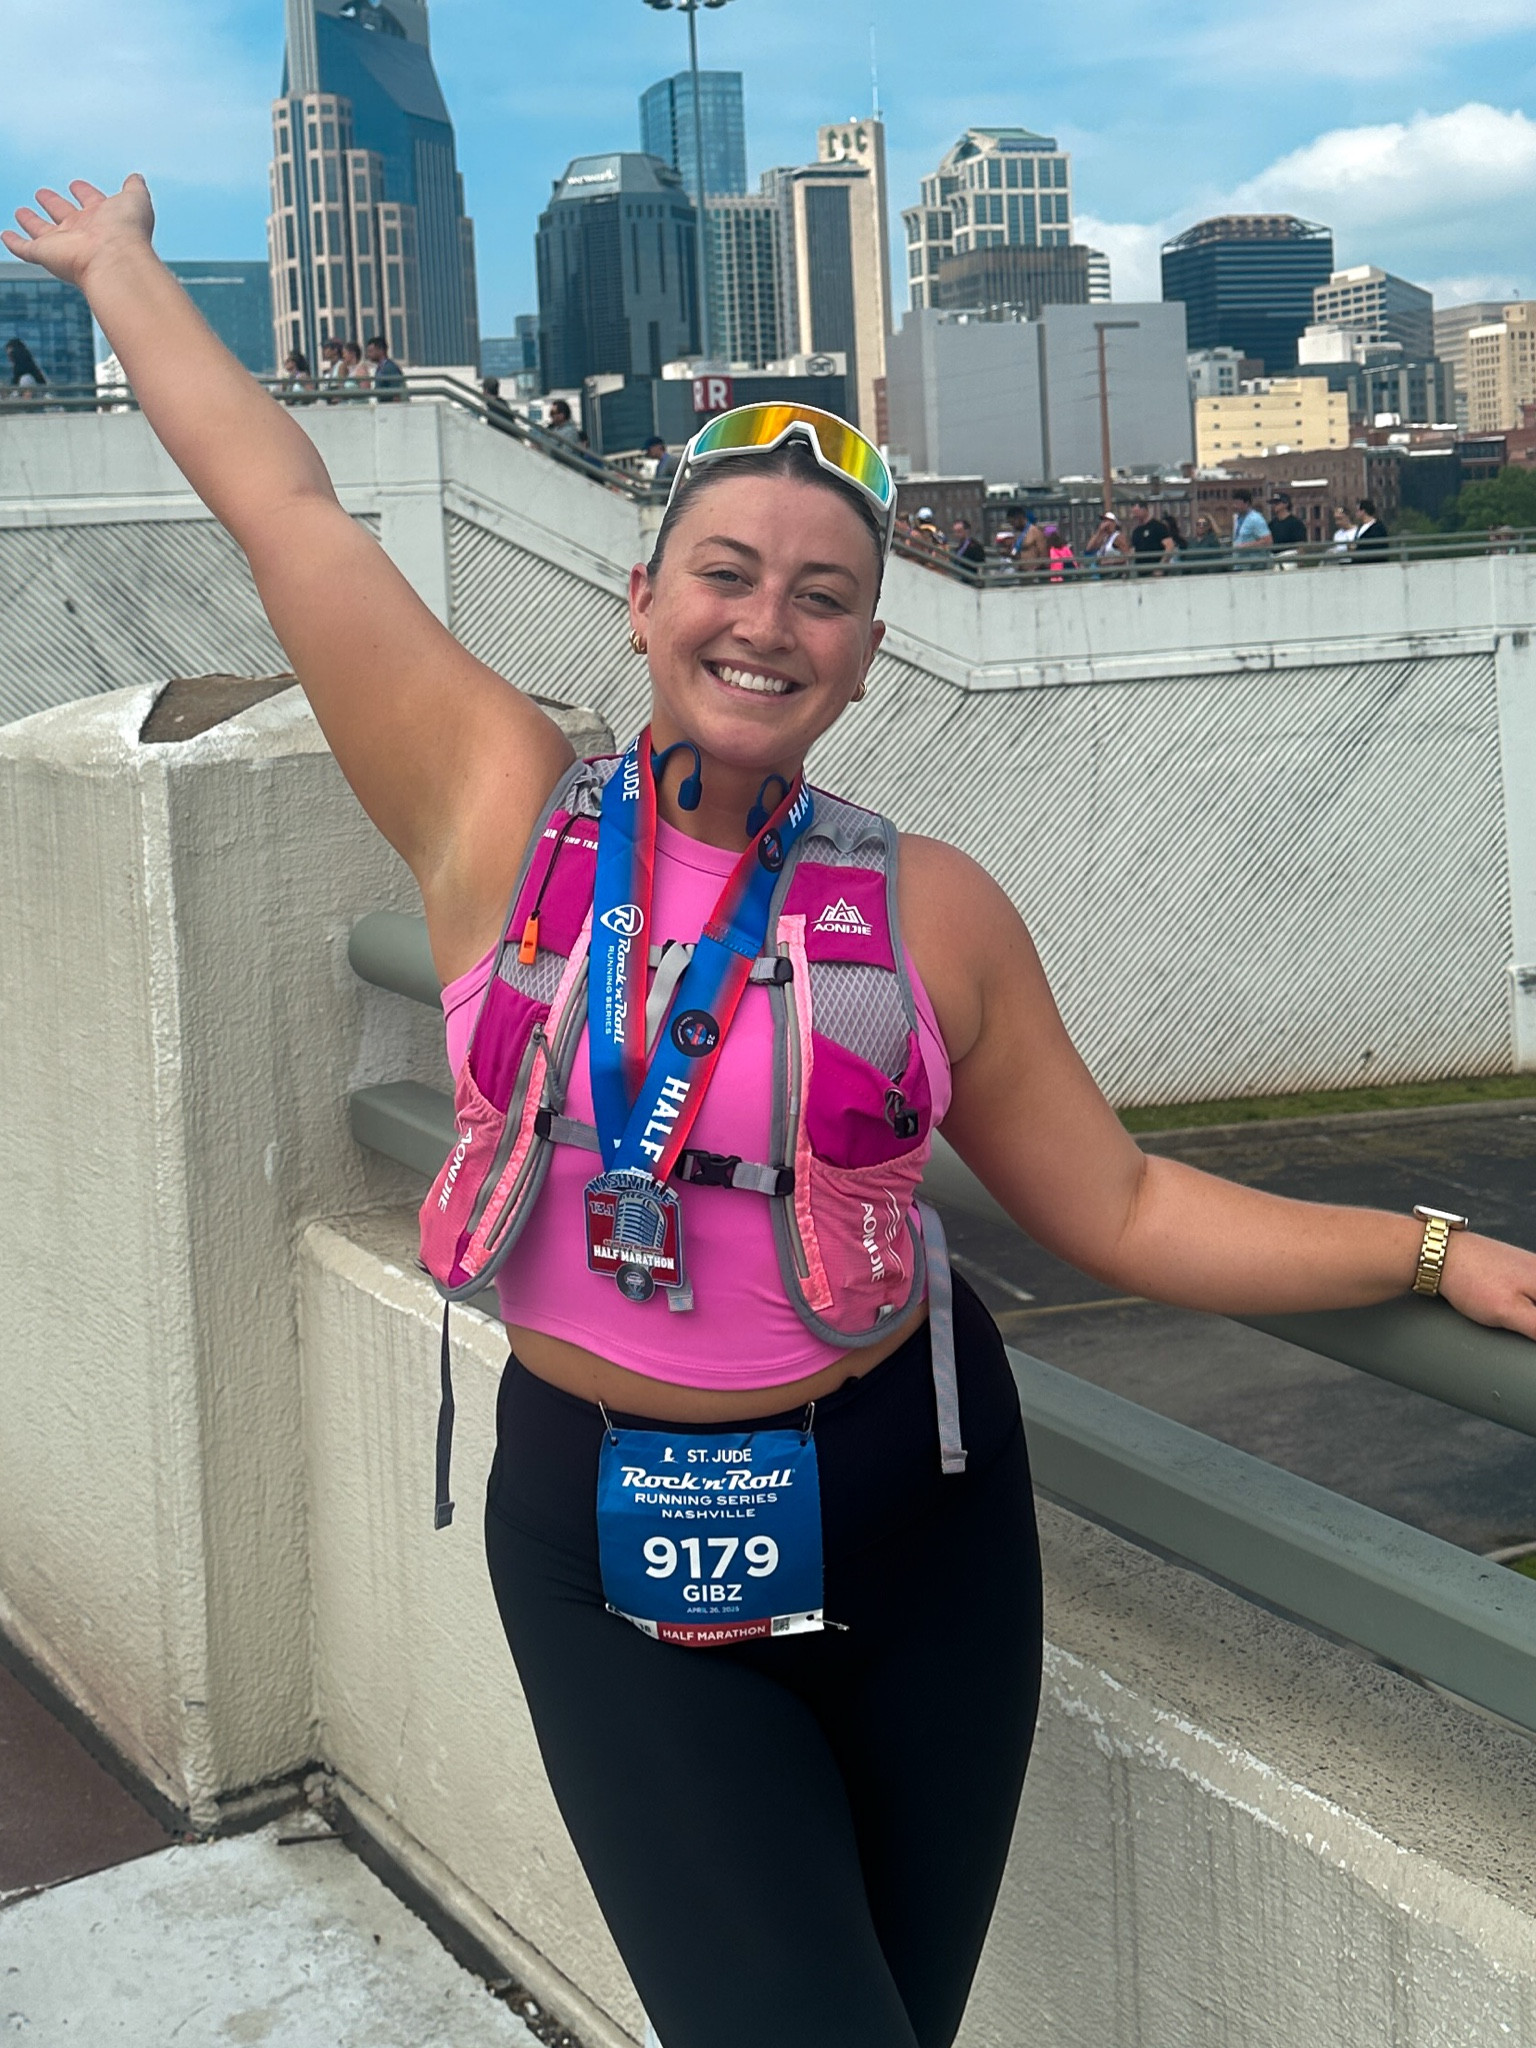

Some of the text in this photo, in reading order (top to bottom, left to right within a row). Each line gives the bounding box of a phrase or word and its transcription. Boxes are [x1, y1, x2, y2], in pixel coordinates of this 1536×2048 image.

[623, 760, 640, 802] JUDE
[813, 923, 872, 936] AONIJIE
[605, 945, 615, 1035] RUNNING SERIES
[640, 1075, 691, 1164] HALF
[438, 1127, 473, 1213] AONIJIE
[588, 1169, 679, 1206] NASHVILLE
[861, 1202, 885, 1283] AONIJIE
[593, 1244, 620, 1261] HALF
[620, 1249, 675, 1271] MARATHON
[687, 1448, 752, 1464] ST. JUDE
[635, 1492, 778, 1506] RUNNING SERIES
[662, 1508, 756, 1519] NASHVILLE
[643, 1535, 779, 1579] 9179
[682, 1583, 742, 1602] GIBZ
[687, 1606, 708, 1614] APRIL
[662, 1624, 766, 1642] HALF MARATHON
